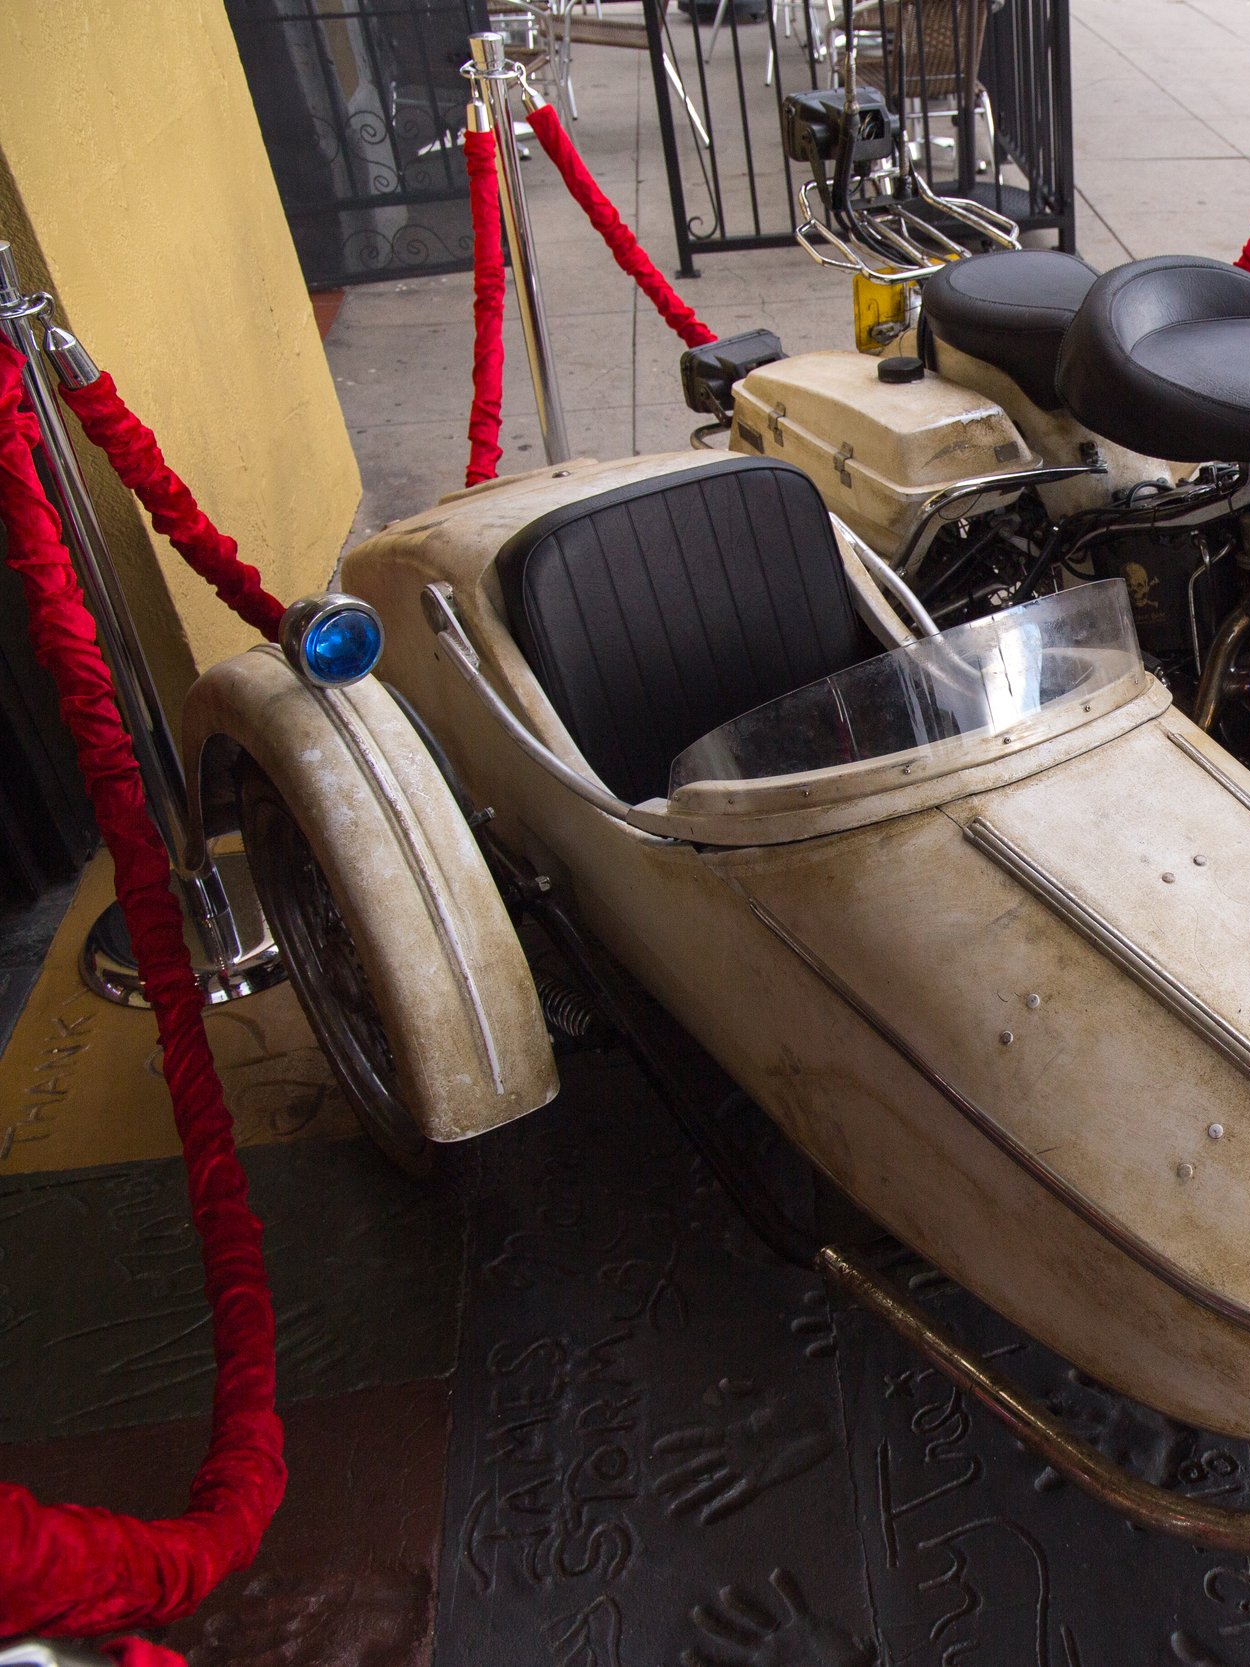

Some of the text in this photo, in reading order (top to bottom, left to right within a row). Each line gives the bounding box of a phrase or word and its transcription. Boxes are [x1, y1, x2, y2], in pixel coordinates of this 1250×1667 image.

[3, 1014, 95, 1160] THANK
[458, 1336, 567, 1591] JAMES
[550, 1330, 642, 1582] STORM
